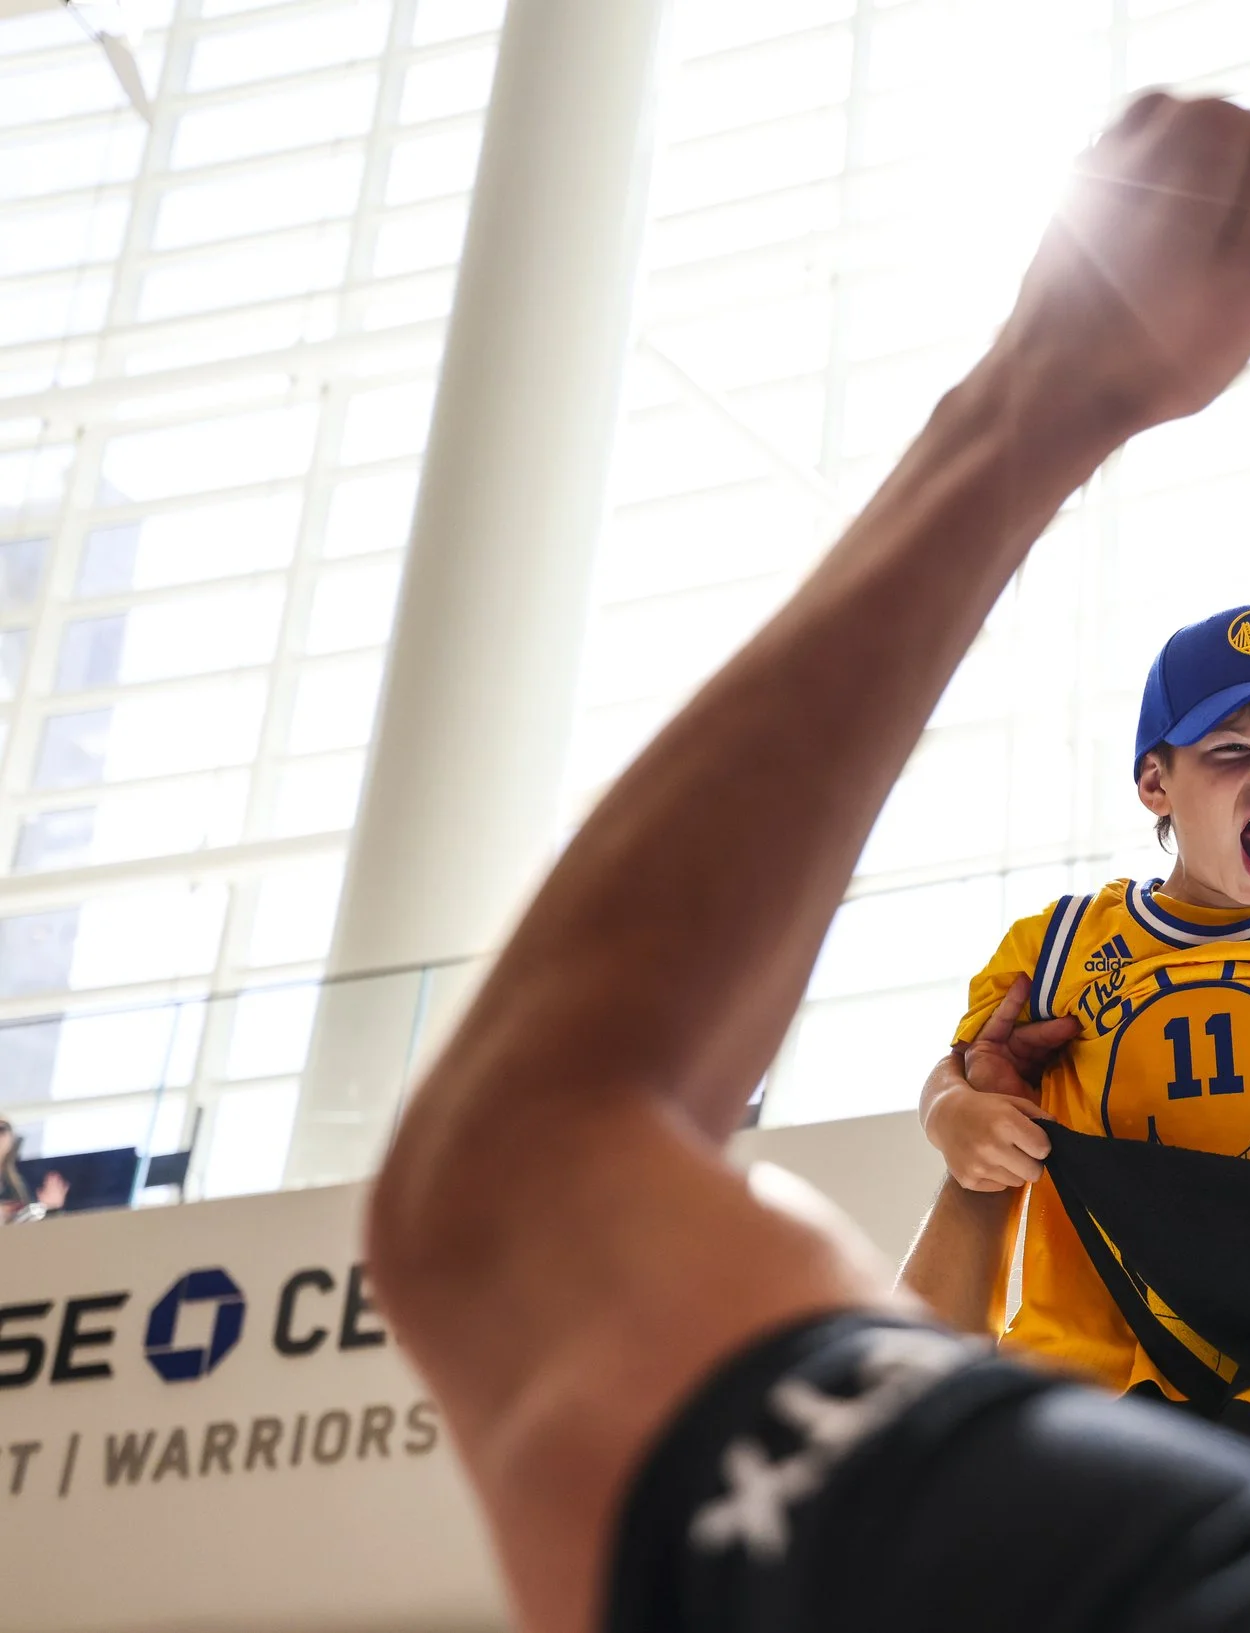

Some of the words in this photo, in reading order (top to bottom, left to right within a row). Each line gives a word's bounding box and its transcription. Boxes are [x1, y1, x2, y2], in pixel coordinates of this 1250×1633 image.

[1078, 970, 1126, 1022] The
[1084, 957, 1134, 972] adid
[1163, 1013, 1245, 1101] 11
[105, 1403, 439, 1487] WARRIORS
